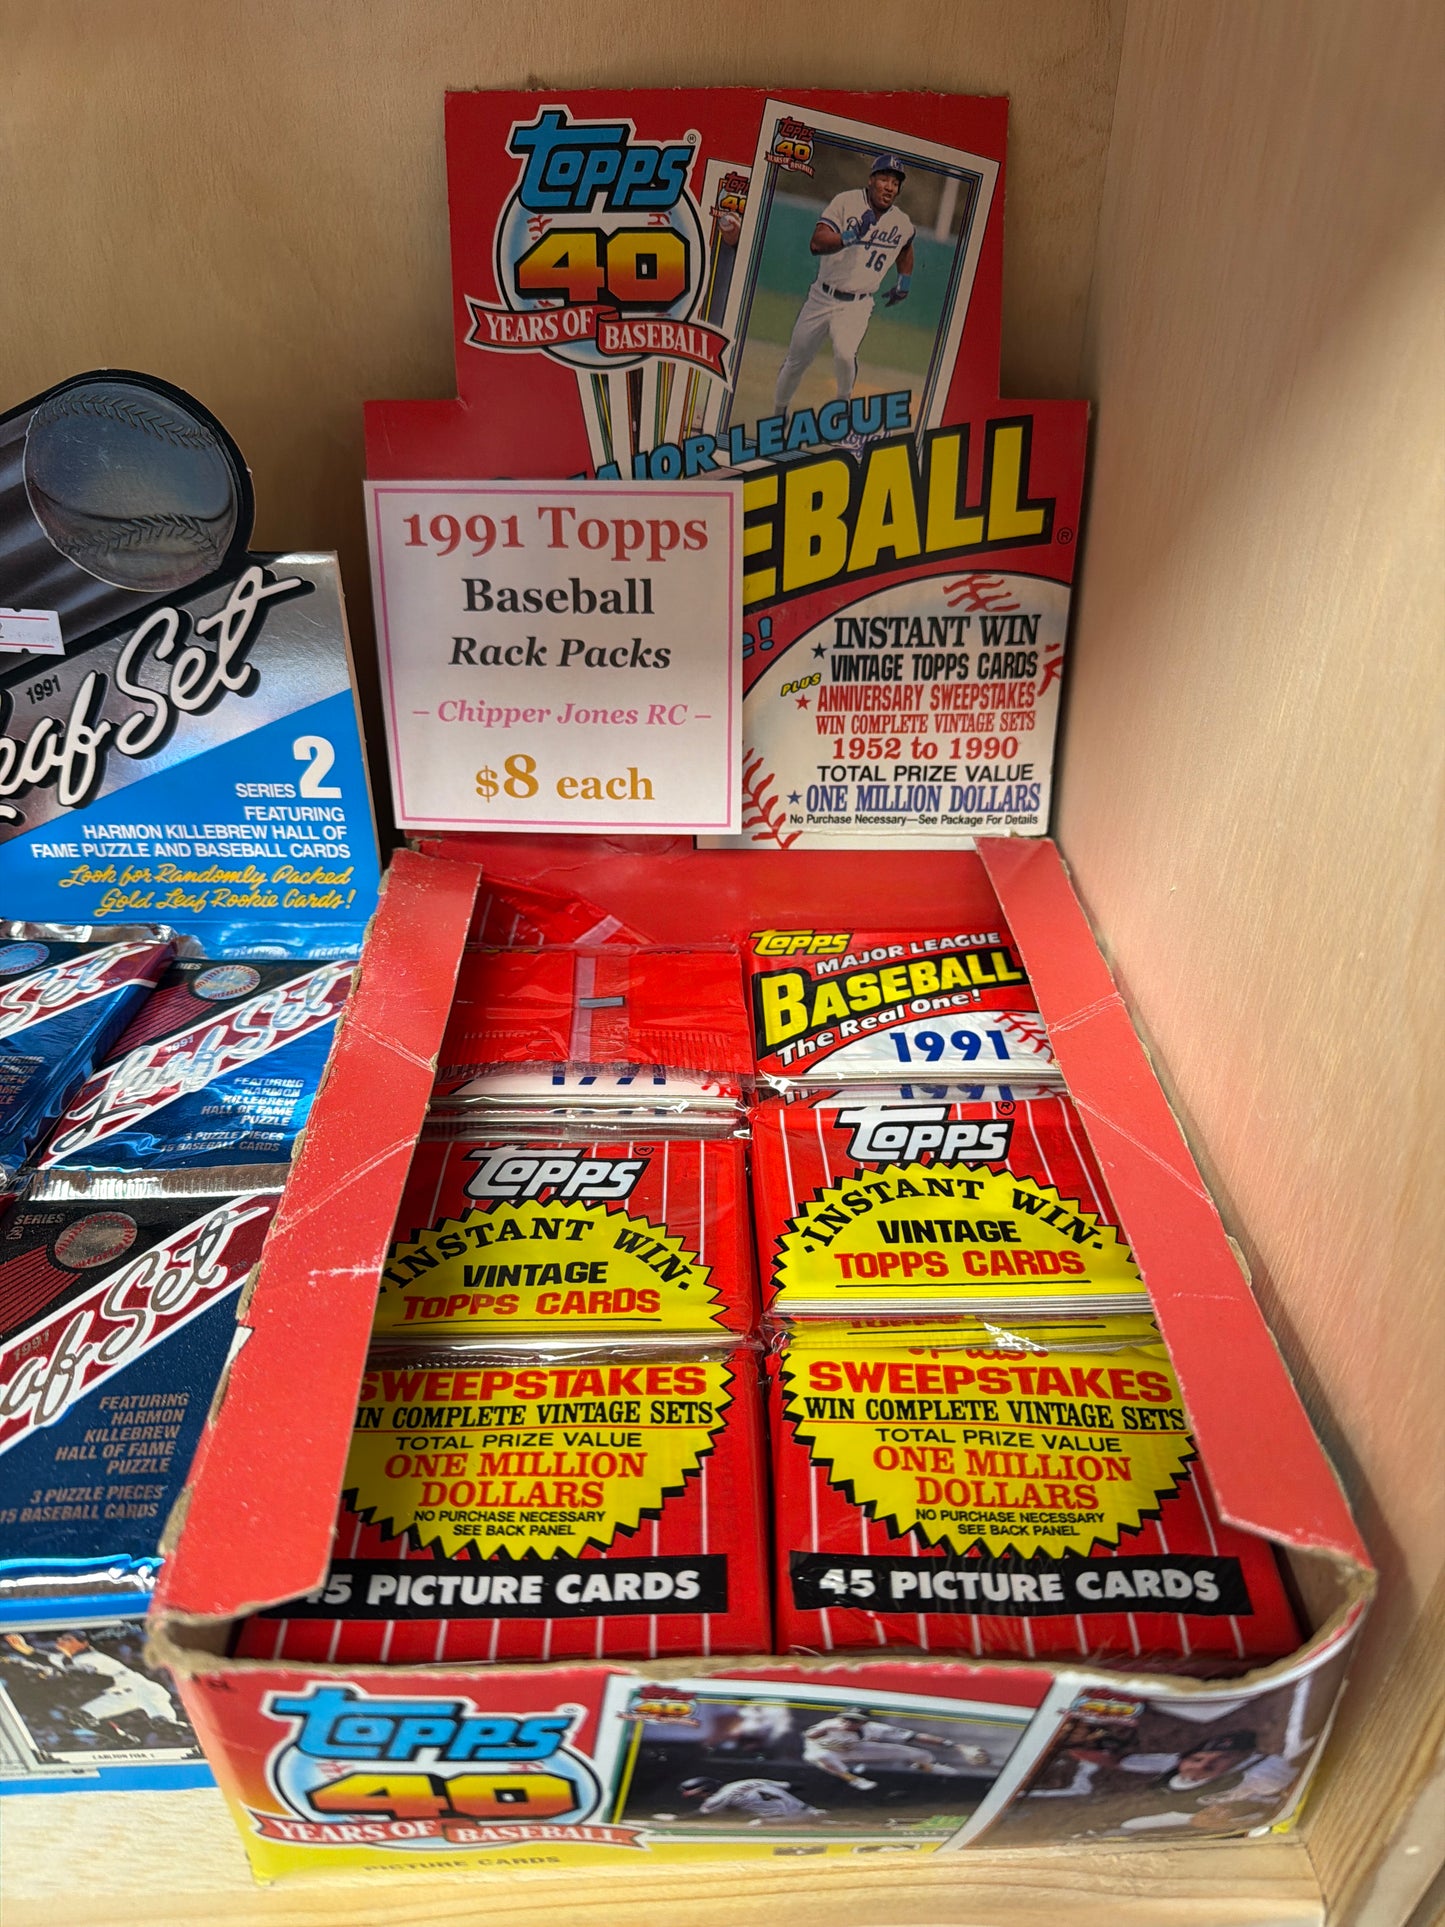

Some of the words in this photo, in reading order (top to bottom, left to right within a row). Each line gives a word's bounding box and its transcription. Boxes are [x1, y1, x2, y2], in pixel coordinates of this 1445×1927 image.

[775, 140, 812, 161] 40
[515, 228, 691, 303] 40
[865, 250, 887, 272] 16
[486, 310, 559, 343] YEARS
[561, 306, 594, 336] OF
[604, 324, 715, 364] BASEBALL
[729, 390, 912, 466] LEAGUE
[403, 513, 525, 556] 1991
[538, 506, 709, 562] Topps
[461, 578, 656, 614] Baseball
[832, 616, 970, 649] INSTANT
[979, 614, 1042, 647] WIN
[115, 566, 302, 756] Set
[448, 637, 548, 667] Rack
[556, 638, 672, 669] Packs
[830, 653, 904, 683] VINTAGE
[912, 653, 969, 681] TOPPS
[977, 650, 1039, 680] CARDS
[26, 675, 61, 705] 1991
[780, 672, 822, 697] PLUS
[817, 684, 924, 713] ANNIVERSARY
[930, 681, 1036, 712] SWEEPSTAKES
[438, 700, 551, 728] Chipper
[557, 703, 639, 725] Jones
[646, 704, 689, 725] RC
[815, 715, 845, 735] WIN
[851, 714, 928, 735] COMPLETE
[934, 712, 995, 733] VINTAGE
[1000, 710, 1036, 732] SETS
[832, 737, 902, 760] 1952
[911, 736, 938, 759] to
[950, 736, 1019, 760] 1990
[235, 783, 297, 799] SERIES
[293, 735, 343, 800] 2
[475, 754, 540, 803] $8
[556, 767, 656, 800] each
[817, 765, 886, 782] TOTAL
[894, 765, 957, 782] PRIZE
[965, 764, 1035, 781] VALUE
[806, 784, 848, 813] ONE
[855, 784, 943, 813] MILLION
[949, 783, 1042, 813] DOLLARS
[245, 806, 345, 823] FEATURING
[790, 814, 804, 825] No
[806, 814, 852, 825] Purchase
[940, 814, 984, 827] Package
[986, 814, 1003, 825] For
[1005, 814, 1039, 825] Details
[83, 825, 164, 840] HARMON
[165, 825, 269, 840] KILLEBREW
[272, 825, 320, 841] HALL
[323, 826, 348, 841] OF
[32, 843, 82, 859] FAME
[84, 843, 152, 859] PUZZLE
[154, 843, 192, 859] AND
[195, 843, 287, 859] BASEBALL
[290, 843, 351, 859] CARDS
[59, 864, 117, 887] Look
[118, 865, 153, 887] for
[155, 863, 267, 890] Randomly
[271, 864, 355, 885] Packed
[94, 888, 152, 917] Gold
[155, 888, 210, 913] Leaf
[211, 888, 278, 909] Rookie
[282, 889, 357, 909] Cards!
[816, 944, 905, 975] MAJOR
[911, 932, 1001, 955] LEAGUE
[761, 951, 1023, 1047] BASEBALL
[776, 1031, 835, 1067] The
[840, 1004, 905, 1037] Real
[910, 989, 982, 1014] One!
[890, 1030, 1012, 1063] 1991
[234, 1077, 304, 1088] FEATURING
[201, 1105, 232, 1115] HALL
[256, 1105, 295, 1116] FAME
[223, 1095, 297, 1106] KILLEBREW
[240, 1115, 291, 1126] PUZZLE
[6, 1226, 24, 1239] 2
[14, 1213, 65, 1225] SERIES
[877, 1220, 1021, 1244] VINTAGE
[463, 1261, 609, 1288] VINTAGE
[834, 1251, 949, 1279] TOPPS
[964, 1249, 1086, 1277] CARDS
[403, 1293, 520, 1320] TOPPS
[535, 1287, 661, 1315] CARDS
[13, 1333, 50, 1361] 1991
[808, 1361, 1173, 1402] SWEEPSTAKES
[99, 1393, 190, 1409] FEATURING
[392, 1404, 527, 1429] COMPLETE
[537, 1400, 641, 1425] VINTAGE
[650, 1401, 714, 1424] SETS
[804, 1397, 855, 1420] WIN
[865, 1397, 999, 1422] COMPLETE
[1010, 1400, 1114, 1429] VINTAGE
[1122, 1406, 1185, 1431] SETS
[111, 1409, 185, 1425] HARMON
[84, 1425, 181, 1443] KILLEBREW
[396, 1434, 474, 1450] TOTAL
[482, 1433, 554, 1448] PRIZE
[562, 1432, 642, 1447] VALUE
[875, 1428, 955, 1445] TOTAL
[963, 1429, 1034, 1448] PRIZE
[1042, 1434, 1123, 1453] VALUE
[55, 1445, 97, 1461] HALL
[103, 1443, 125, 1458] OF
[127, 1440, 177, 1456] FAME
[873, 1446, 954, 1474] ONE
[966, 1449, 1132, 1482] MILLION
[106, 1458, 170, 1475] PUZZLE
[384, 1453, 467, 1479] ONE
[476, 1451, 647, 1478] MILLION
[30, 1490, 42, 1504] 3
[44, 1486, 104, 1503] PUZZLE
[106, 1485, 163, 1500] PIECES
[418, 1481, 605, 1509] DOLLARS
[915, 1476, 1100, 1510] DOLLARS
[19, 1504, 99, 1523] BASEBALL
[104, 1502, 159, 1519] CARDS
[414, 1511, 436, 1522] NO
[438, 1511, 518, 1523] PURCHASE
[519, 1510, 605, 1523] NECESSARY
[915, 1509, 937, 1521] NO
[939, 1510, 1016, 1523] PURCHASE
[1018, 1511, 1106, 1524] NECESSARY
[453, 1525, 482, 1536] SEE
[485, 1525, 527, 1537] BACK
[529, 1525, 575, 1536] PANEL
[957, 1523, 987, 1536] SEE
[989, 1524, 1031, 1537] BACK
[1033, 1524, 1080, 1537] PANEL
[366, 1574, 543, 1606] PICTURE
[555, 1570, 701, 1603] CARDS
[819, 1569, 875, 1597] 45
[890, 1569, 1065, 1602] PICTURE
[1076, 1568, 1221, 1601] CARDS
[312, 1772, 578, 1819] 40
[271, 1822, 387, 1843] YEARS
[391, 1819, 437, 1840] OF
[456, 1826, 622, 1844] BASEBALL
[363, 1860, 469, 1871] PICTURE
[478, 1856, 561, 1866] CARDS
